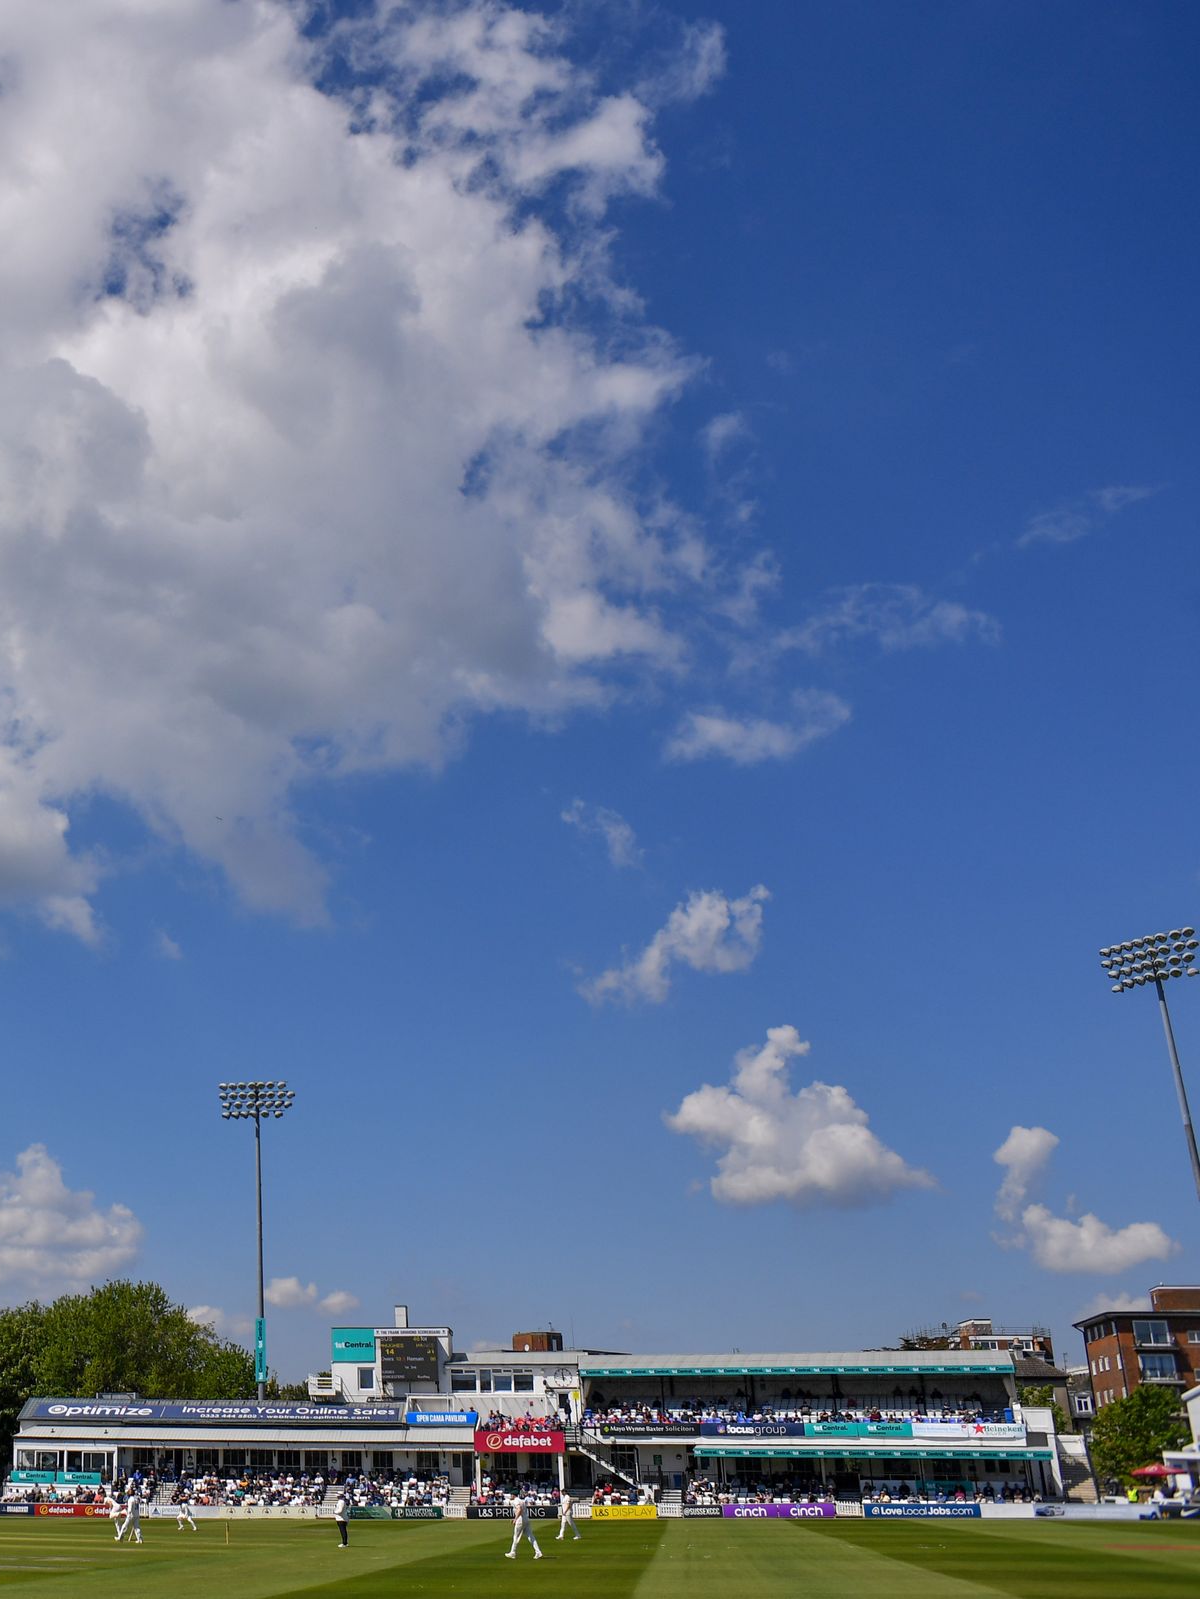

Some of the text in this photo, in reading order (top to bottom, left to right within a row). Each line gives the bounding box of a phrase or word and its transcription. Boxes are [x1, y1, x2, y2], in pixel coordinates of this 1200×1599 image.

[48, 1404, 152, 1416] Optimize
[984, 1424, 1022, 1432] Heineken
[504, 1434, 551, 1448] dafabet
[478, 1508, 494, 1517] L&S
[595, 1508, 654, 1517] L&S DISPLAY
[734, 1505, 767, 1517] cinch
[790, 1505, 823, 1516] cinch
